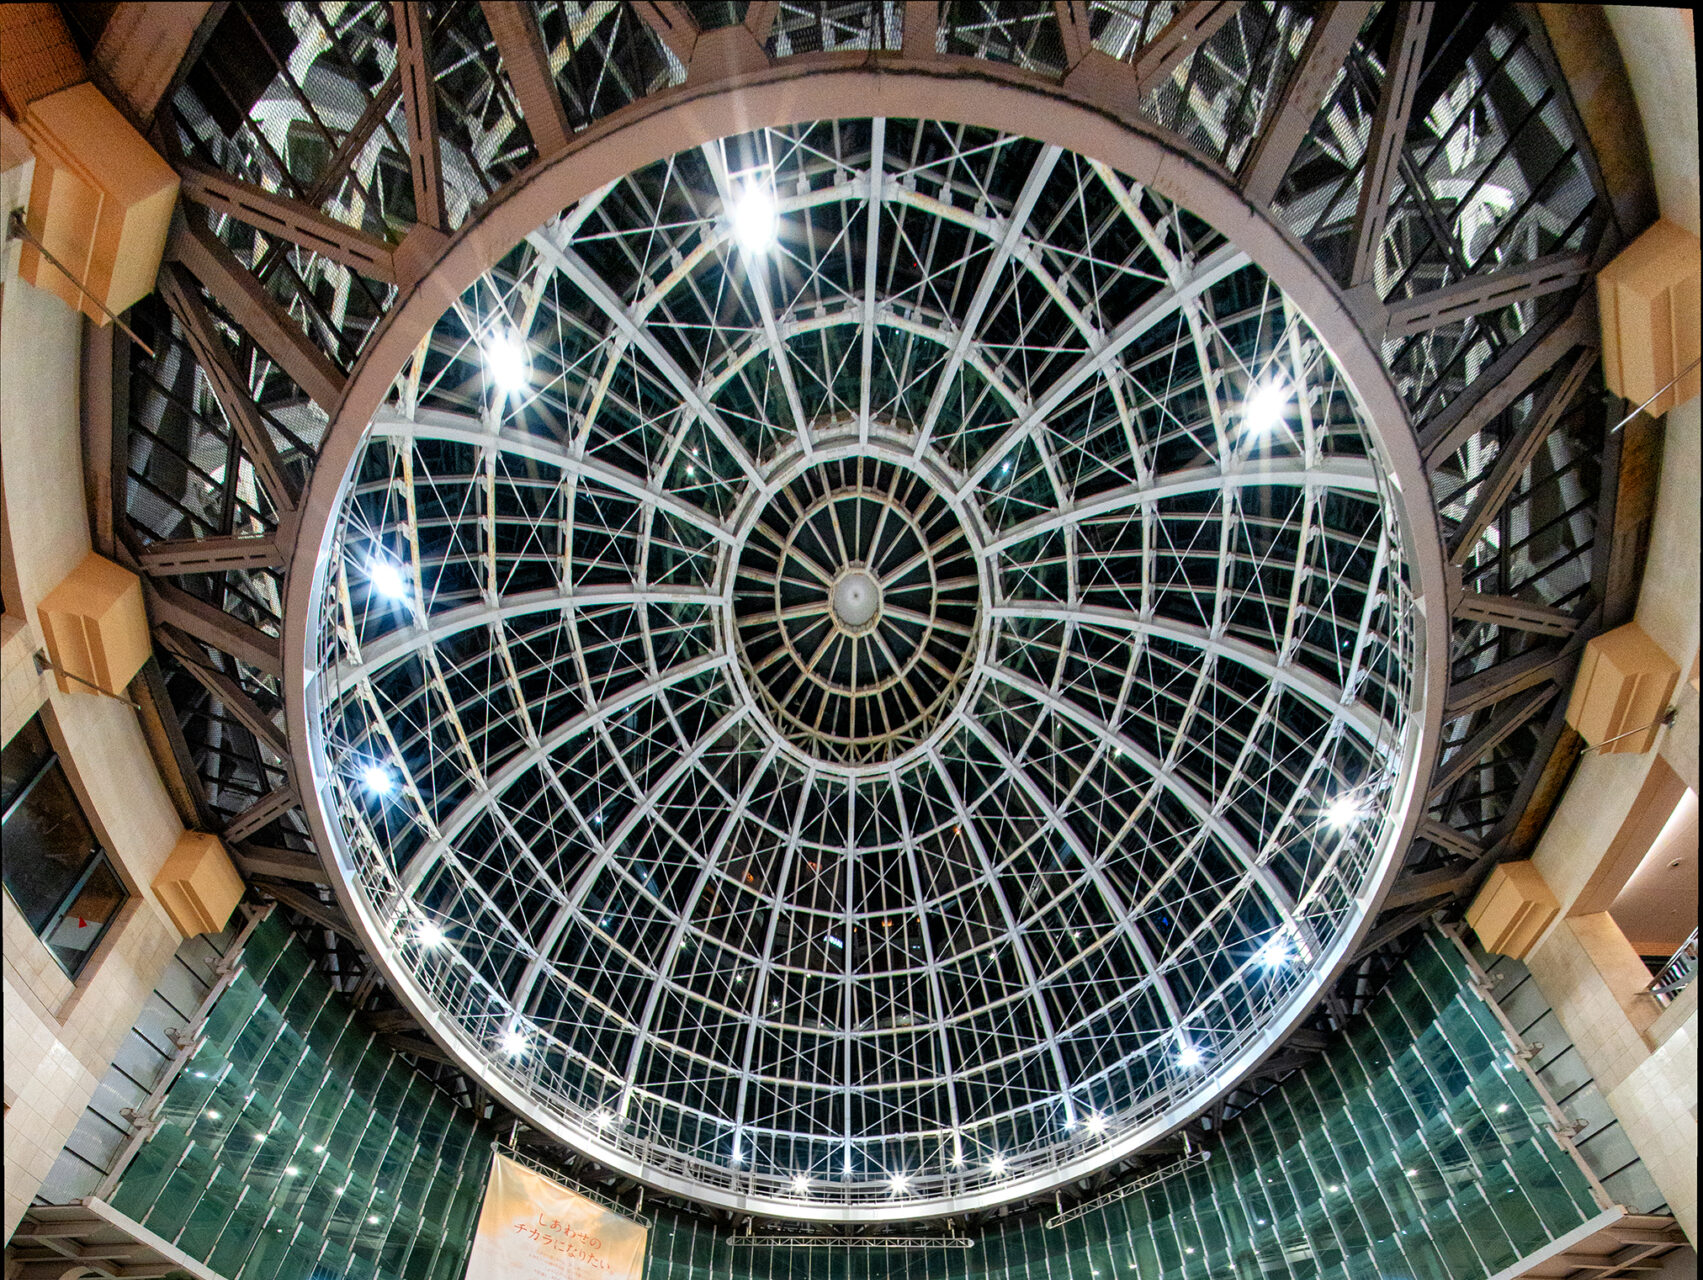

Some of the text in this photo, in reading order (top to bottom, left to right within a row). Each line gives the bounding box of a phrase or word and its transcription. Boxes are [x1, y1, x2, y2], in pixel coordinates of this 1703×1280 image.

[538, 1213, 602, 1250] しあわせの
